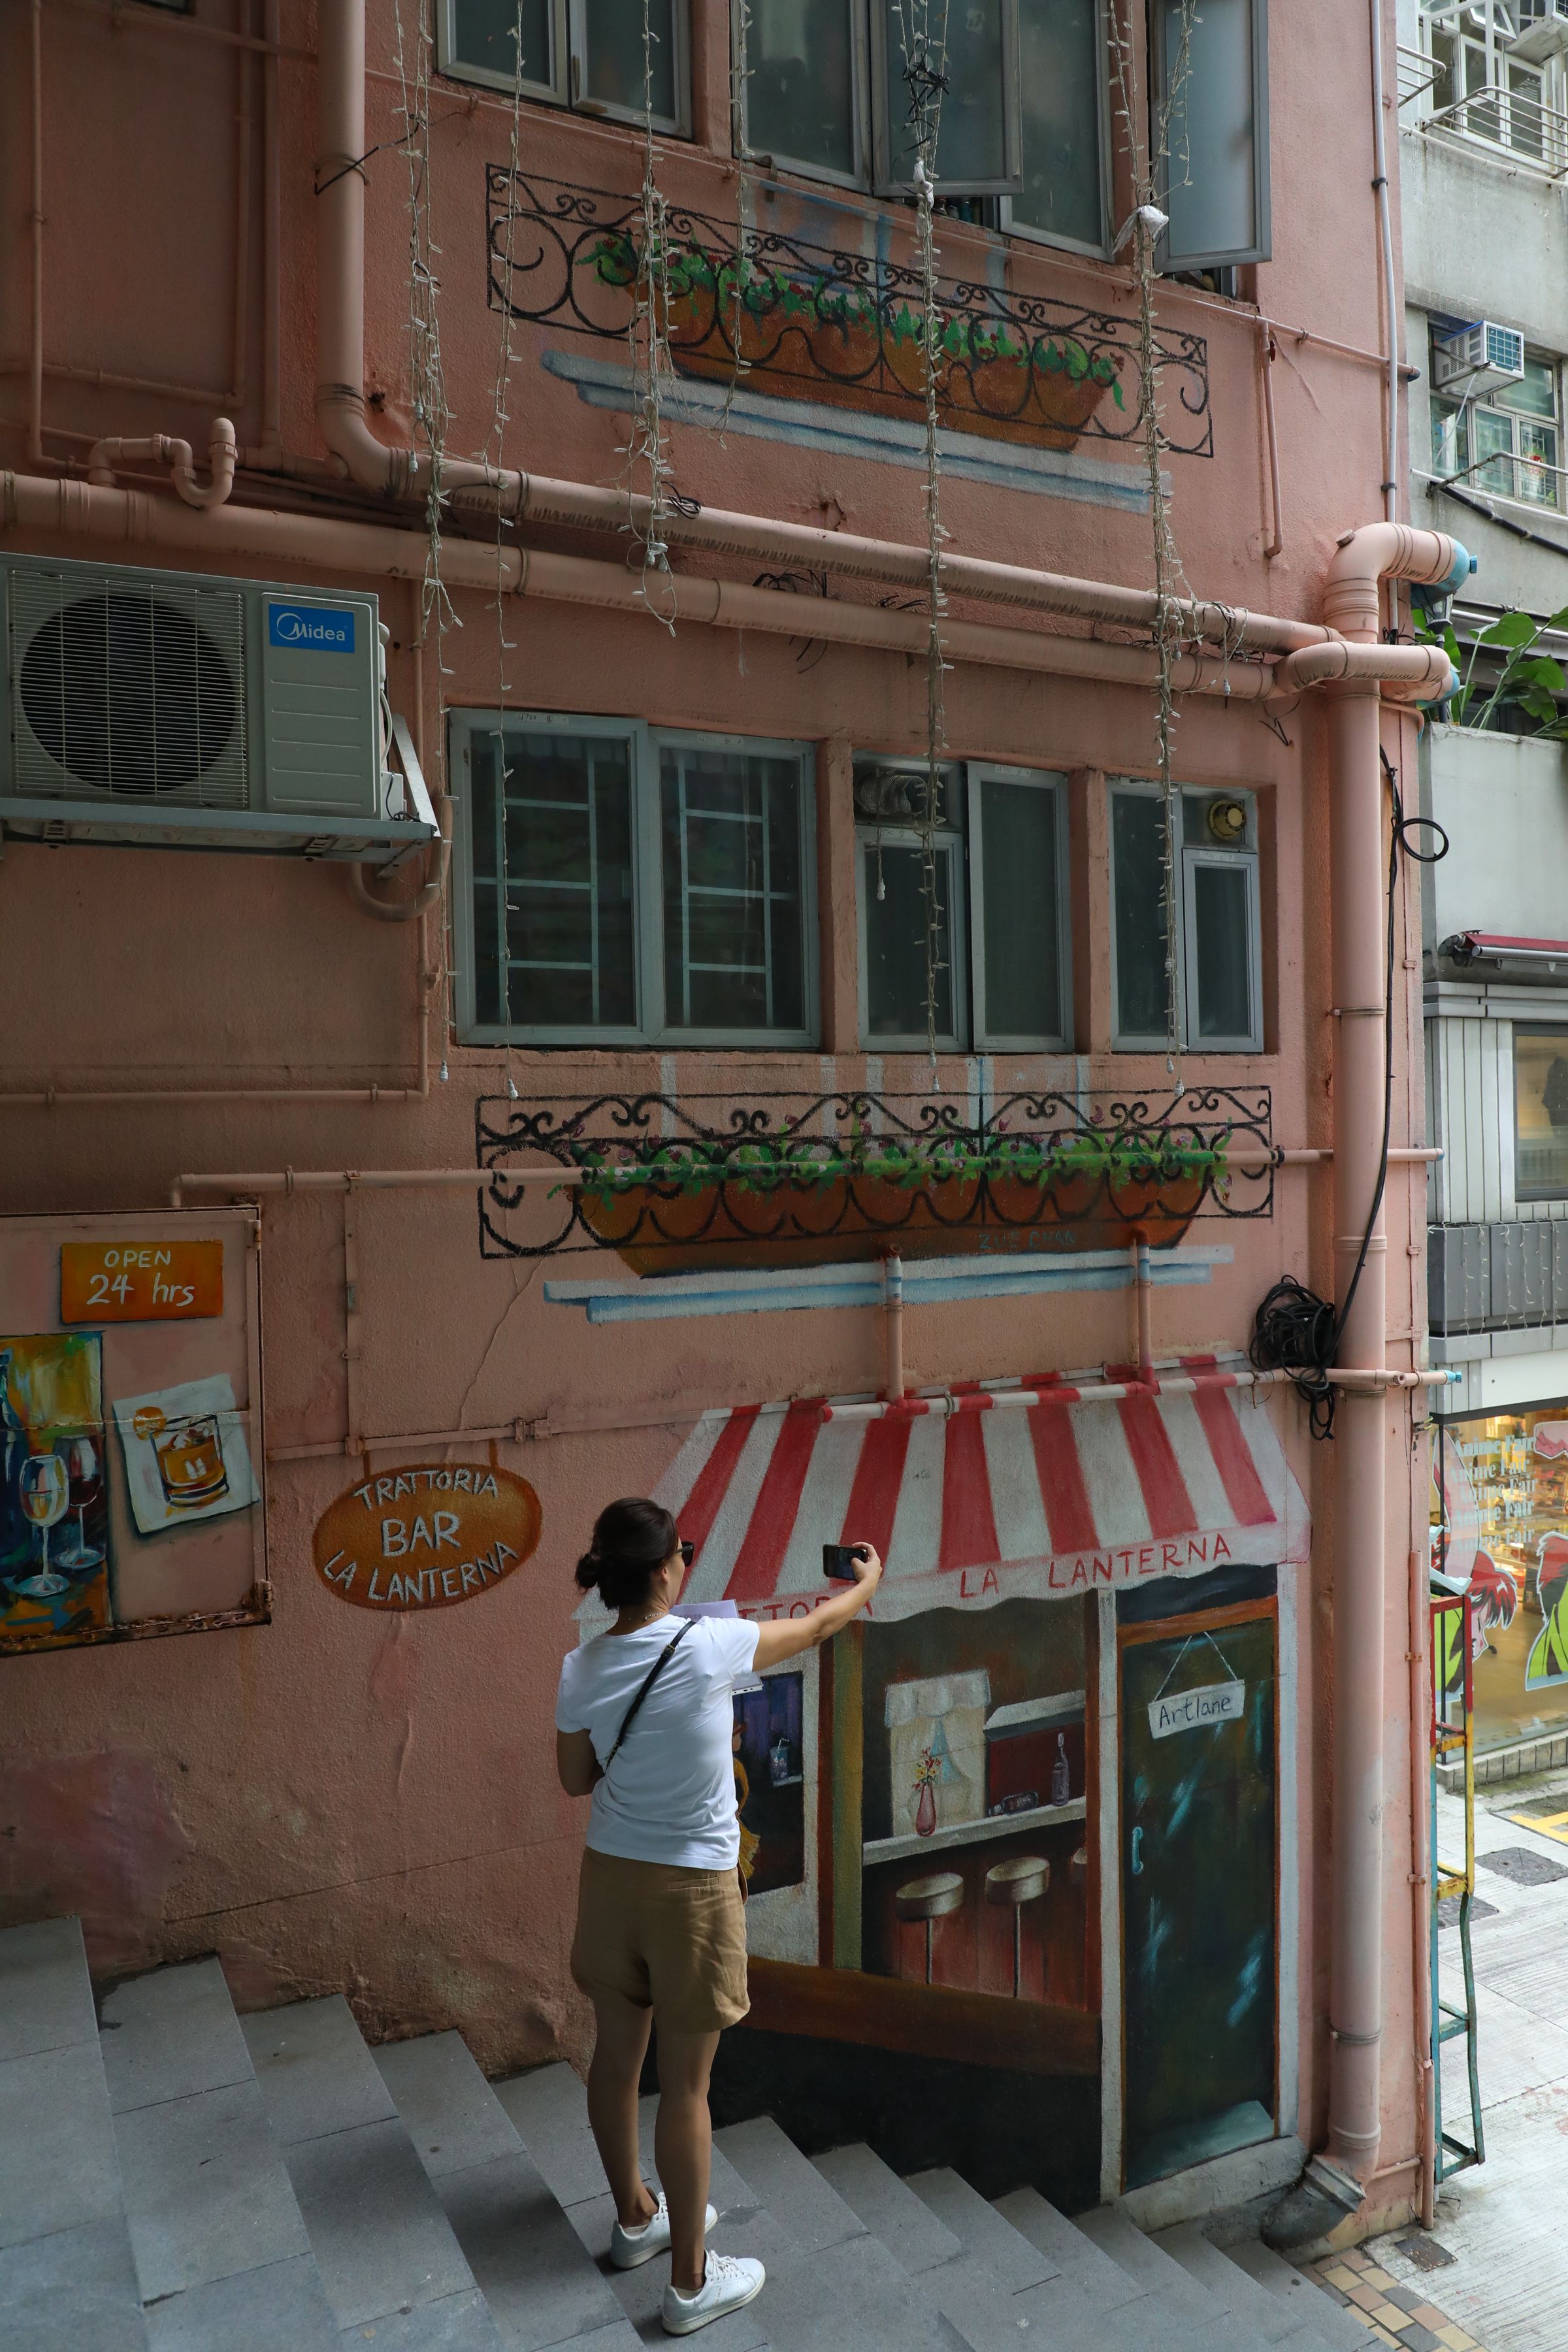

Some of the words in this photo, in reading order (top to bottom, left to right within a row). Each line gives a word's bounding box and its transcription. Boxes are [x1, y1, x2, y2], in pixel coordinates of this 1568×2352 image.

[286, 620, 346, 642] Midea
[104, 1250, 171, 1268] OPEN
[86, 1274, 135, 1305] 24
[152, 1273, 195, 1307] hrs
[1454, 1437, 1501, 1458] Anime
[1505, 1432, 1535, 1452] Fair
[1450, 1462, 1496, 1484] Anime
[1500, 1455, 1529, 1476] Fair
[352, 1468, 499, 1510] TRATTORIA
[1509, 1475, 1538, 1496] Fair
[1505, 1496, 1535, 1519] Fair
[381, 1511, 461, 1557] BAR
[1505, 1525, 1535, 1545] Fair
[323, 1549, 357, 1590] LA
[368, 1541, 519, 1603] LANTERNA
[959, 1567, 999, 1598] LA
[1049, 1533, 1232, 1589] LANTERNA
[1159, 1696, 1232, 1729] Artlane
